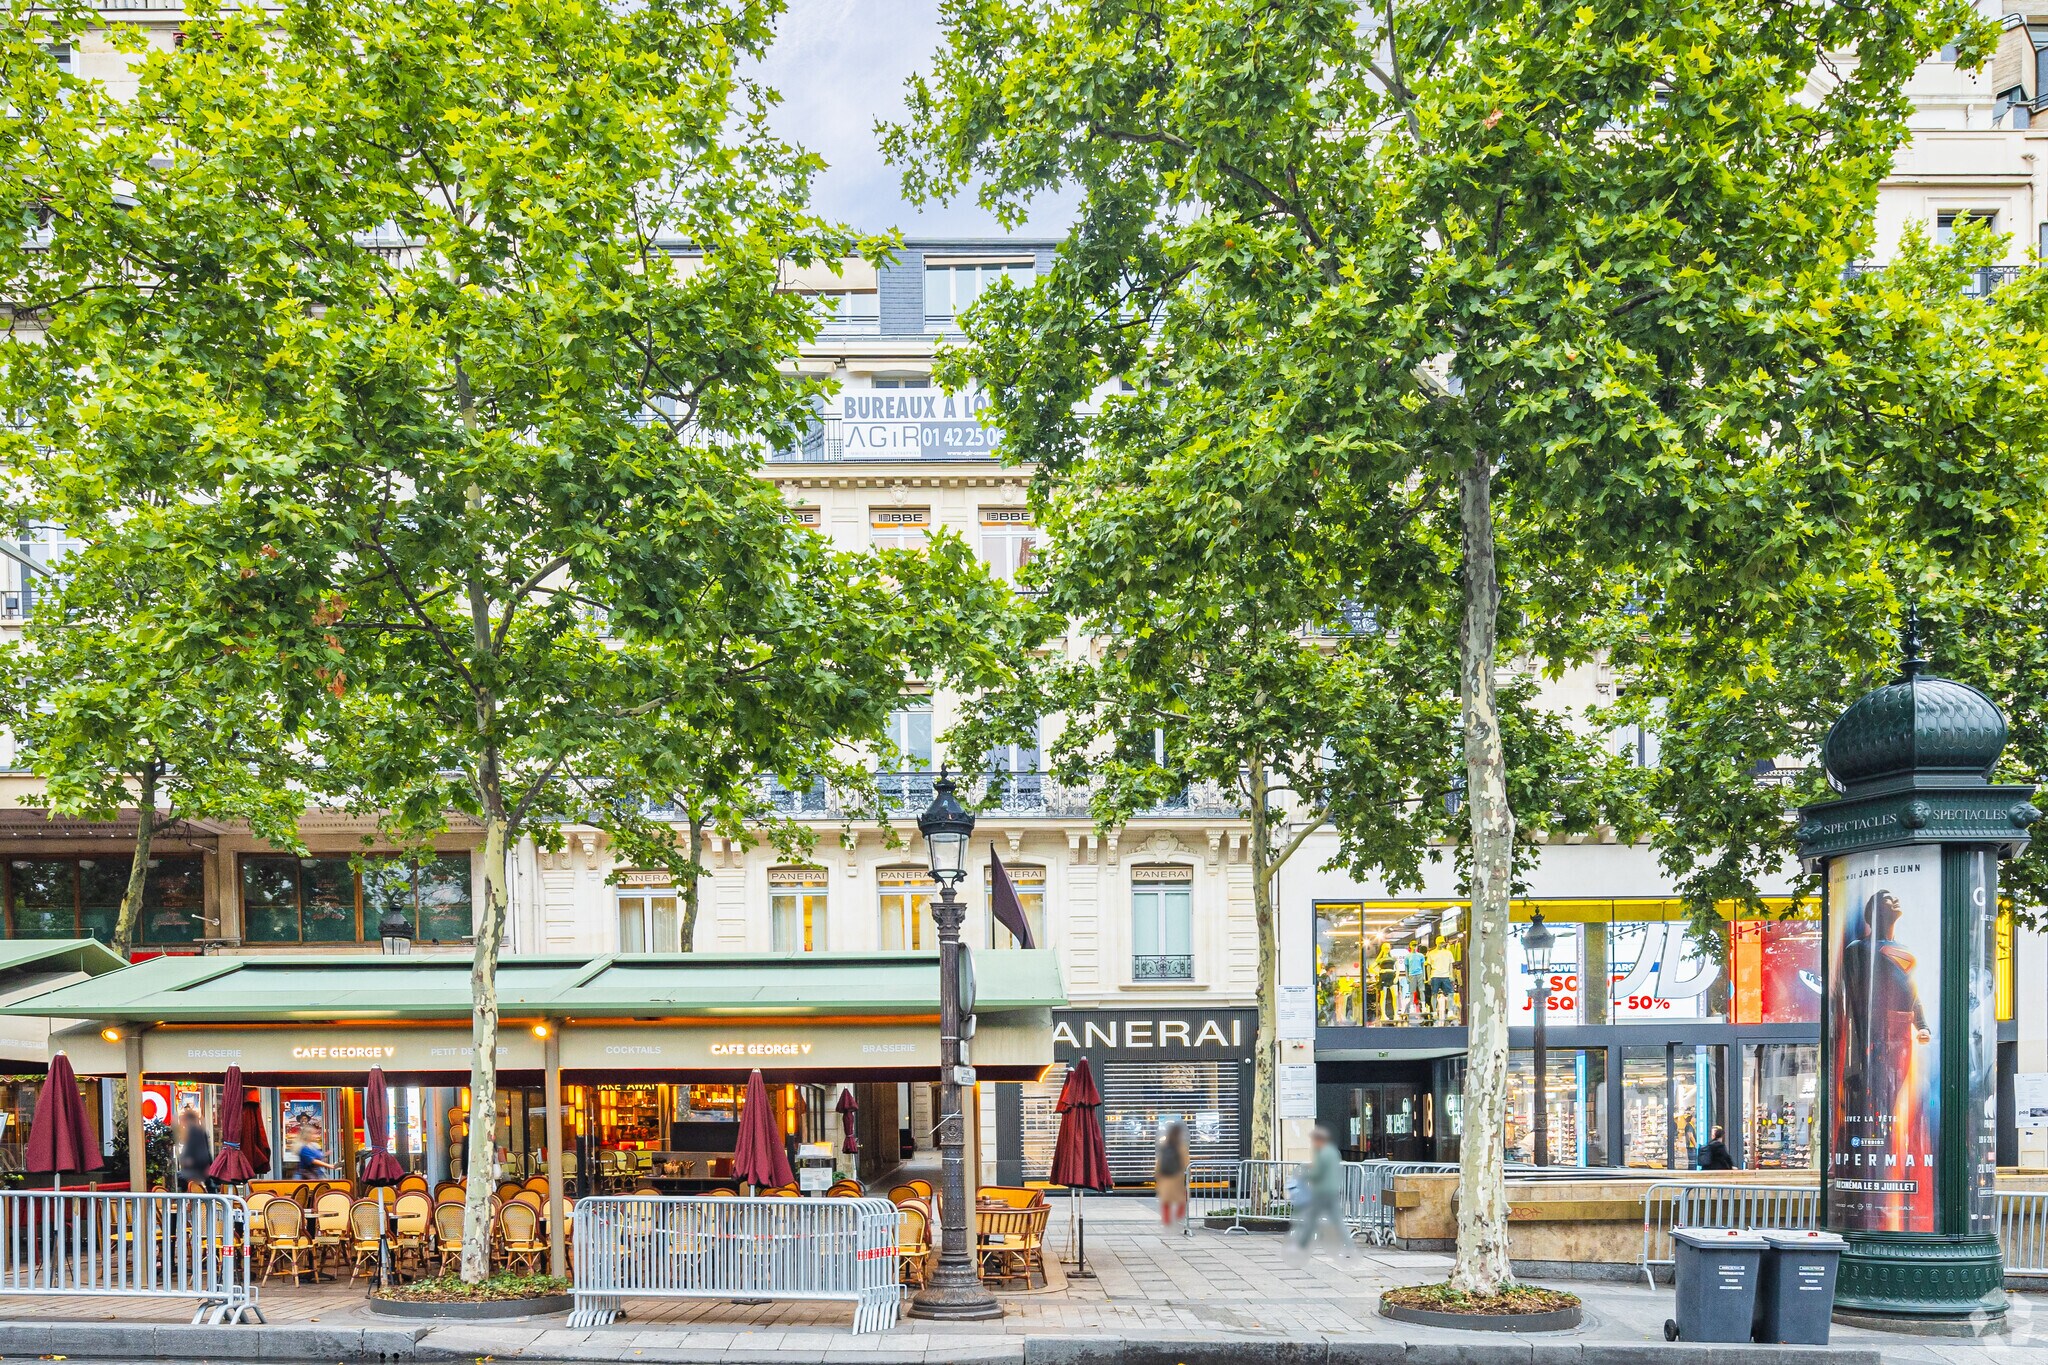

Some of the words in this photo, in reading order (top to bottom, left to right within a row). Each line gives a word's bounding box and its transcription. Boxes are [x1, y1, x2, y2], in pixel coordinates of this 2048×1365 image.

[844, 396, 936, 419] BUREAUX
[965, 396, 993, 419] LO
[922, 428, 940, 447] 01
[944, 428, 963, 447] 42
[965, 428, 984, 447] 25
[1932, 809, 2008, 820] SPECTACLES
[1823, 814, 1897, 835] SPECTACLES
[771, 872, 825, 880] PANERAI
[1135, 870, 1189, 878] PANERAI
[1859, 866, 1889, 878] JAMES
[1893, 864, 1920, 874] GUNN
[1628, 996, 1670, 1009] 50%
[1053, 1020, 1240, 1048] ANERAI
[188, 1049, 242, 1058] BRASSERIE
[293, 1047, 327, 1058] CAFE
[329, 1047, 382, 1058] GEORGE
[384, 1047, 395, 1057] V
[431, 1048, 456, 1056] PETIT
[605, 1046, 661, 1055] COCKTAILS
[711, 1044, 745, 1055] CAFE
[747, 1044, 798, 1055] GEORGE
[800, 1044, 812, 1055] V
[862, 1044, 916, 1053] BRASSERIE
[1841, 1180, 1862, 1189] CINÉMA
[1881, 1183, 1915, 1191] JUILLET
